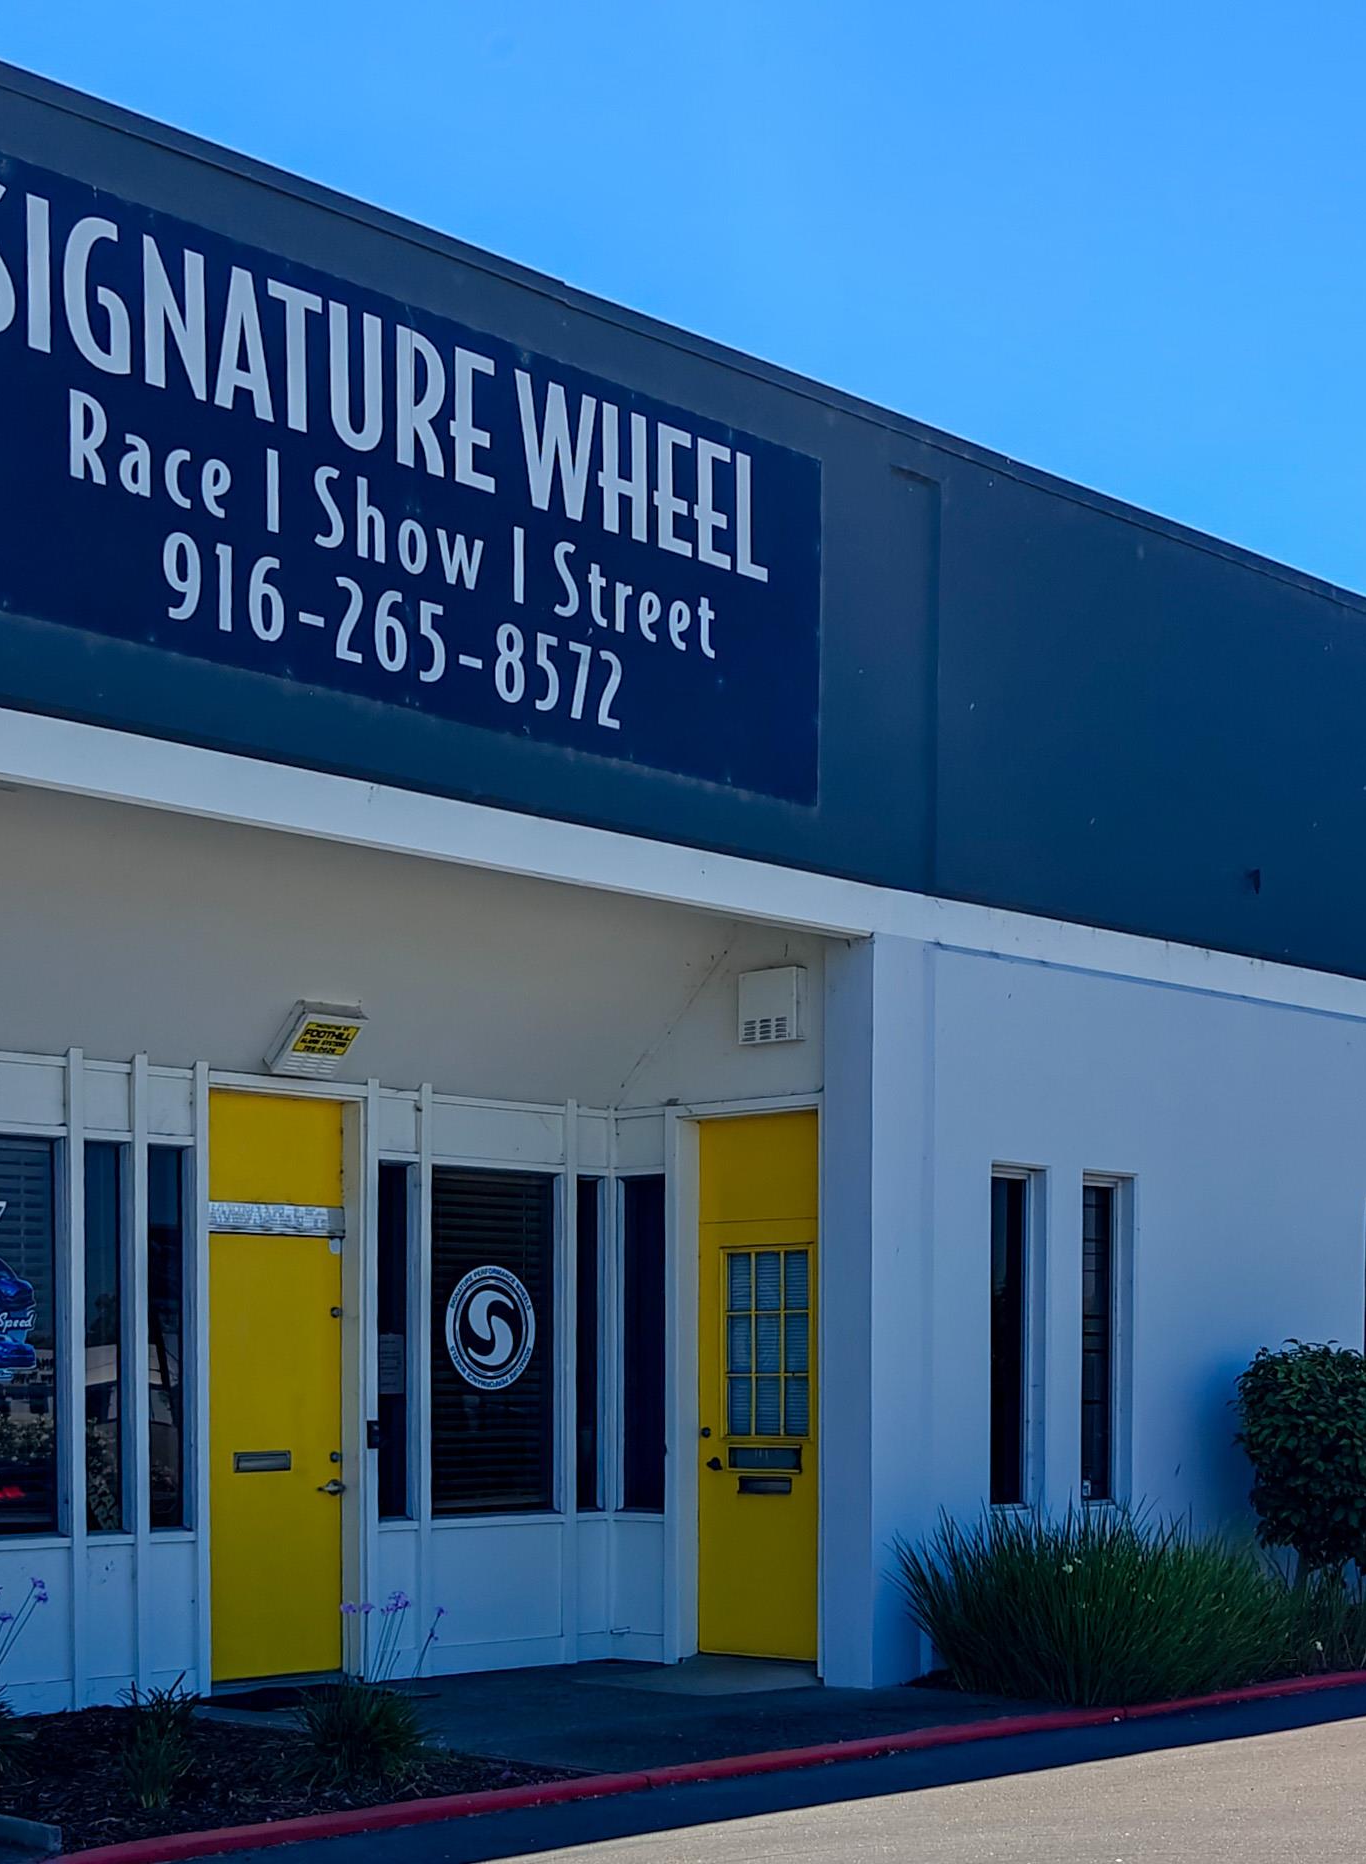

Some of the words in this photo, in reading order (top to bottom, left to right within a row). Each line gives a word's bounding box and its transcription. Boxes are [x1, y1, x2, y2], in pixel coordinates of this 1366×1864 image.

[69, 388, 232, 519] Race
[314, 465, 484, 590] Show
[553, 541, 716, 659] Street
[515, 368, 768, 583] WHEEL
[163, 531, 623, 730] 916-265-8572
[304, 1028, 353, 1042] FOOTHILL
